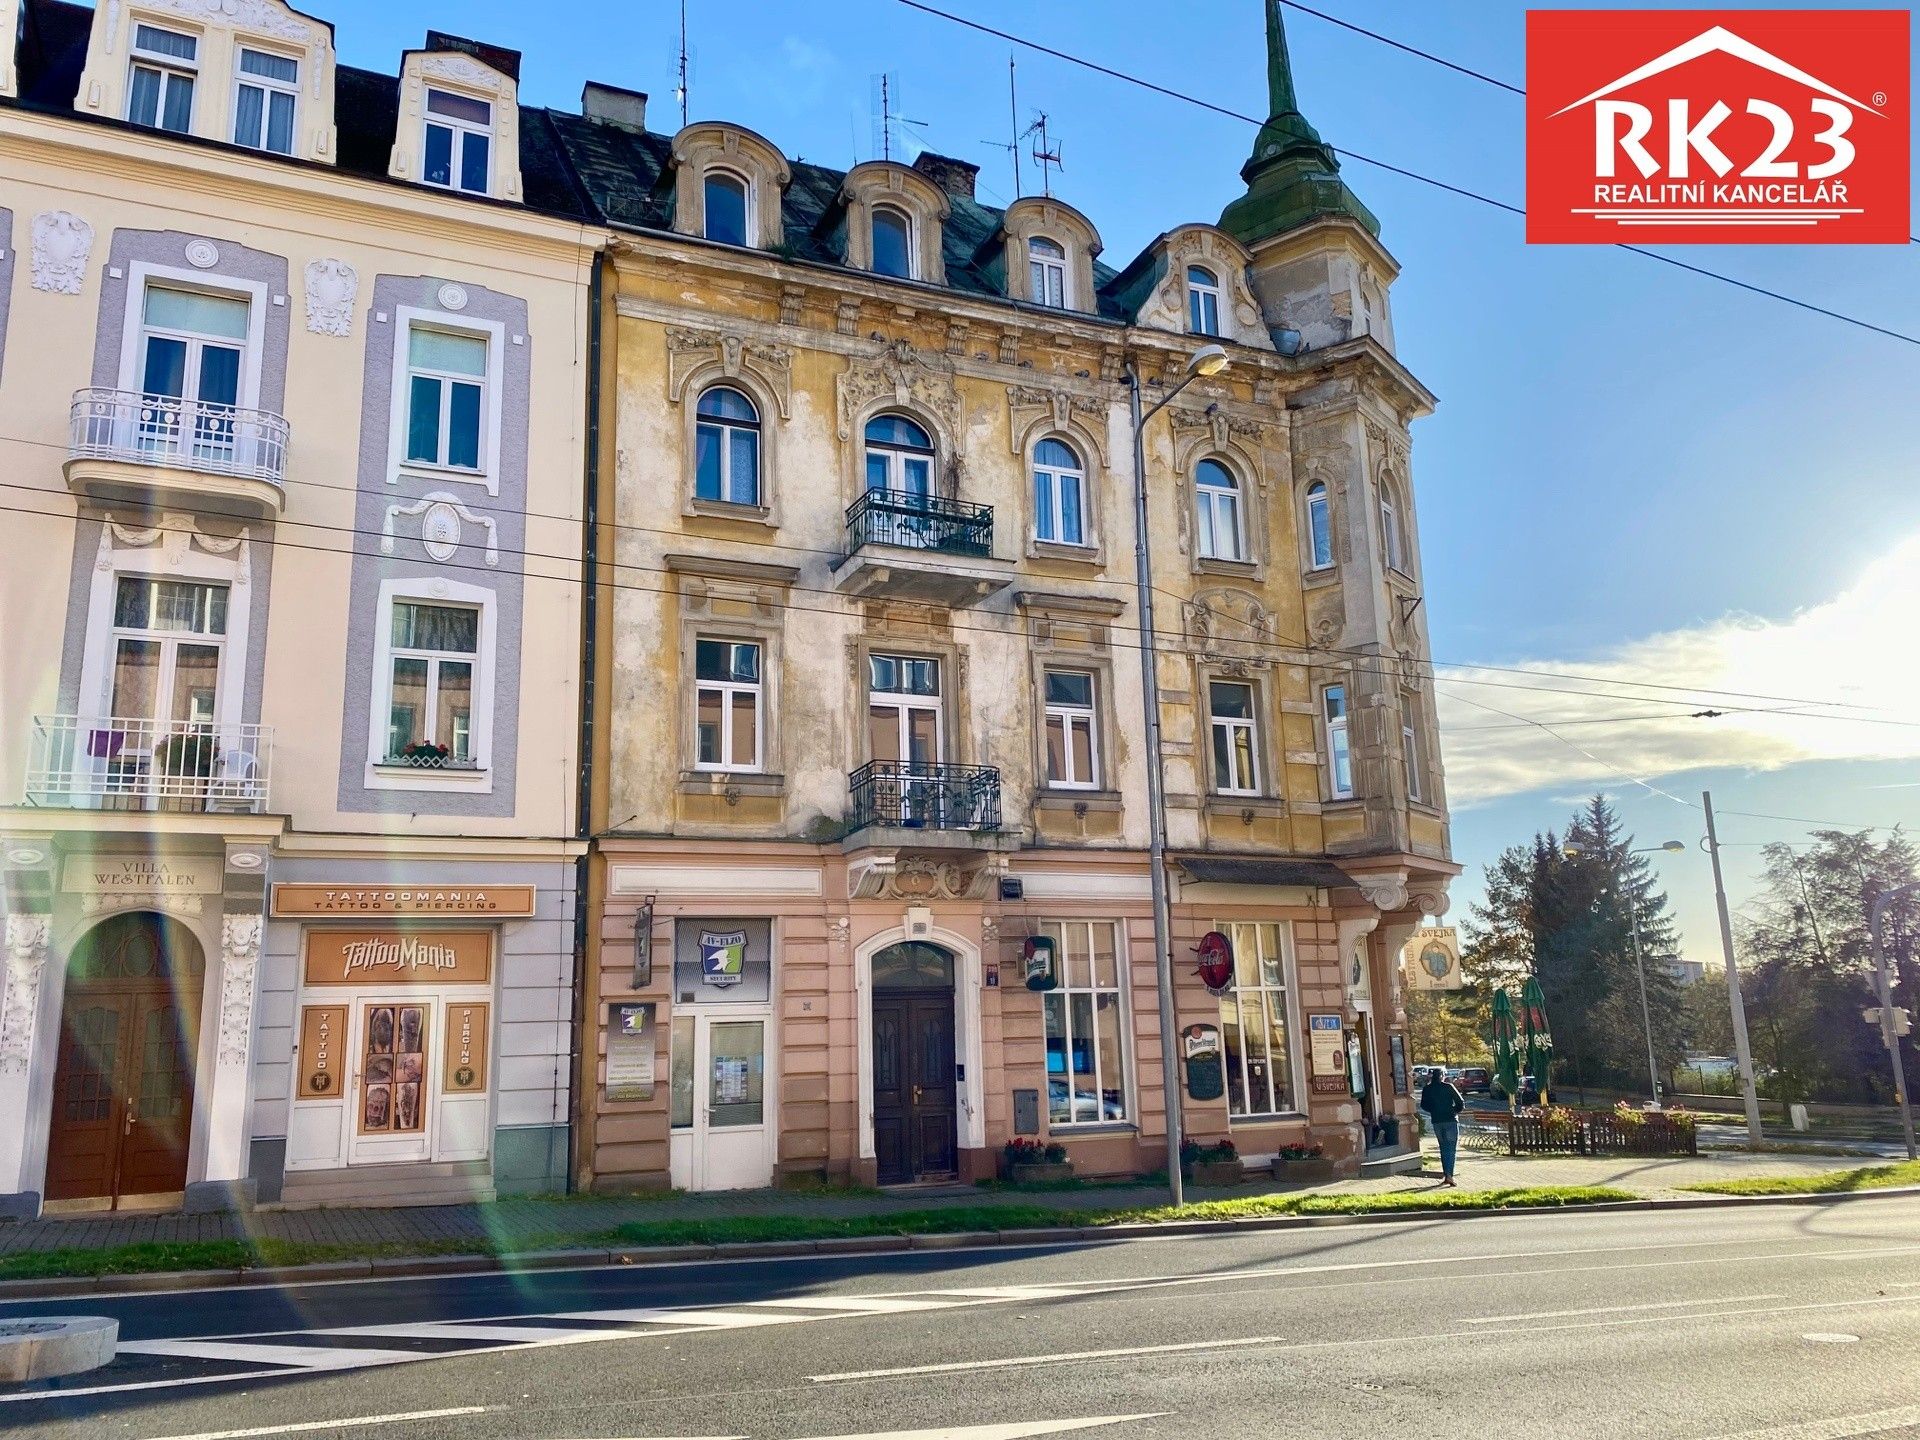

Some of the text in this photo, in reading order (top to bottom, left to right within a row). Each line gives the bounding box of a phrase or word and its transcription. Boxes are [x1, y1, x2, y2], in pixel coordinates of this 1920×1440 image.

[94, 873, 195, 886] WESTFALEN
[122, 863, 169, 873] VILLA
[326, 892, 487, 901] TATTOOMANIA
[342, 936, 457, 980] TattooMania
[317, 1013, 330, 1069] TATTOO
[460, 1009, 472, 1065] PIERCING
